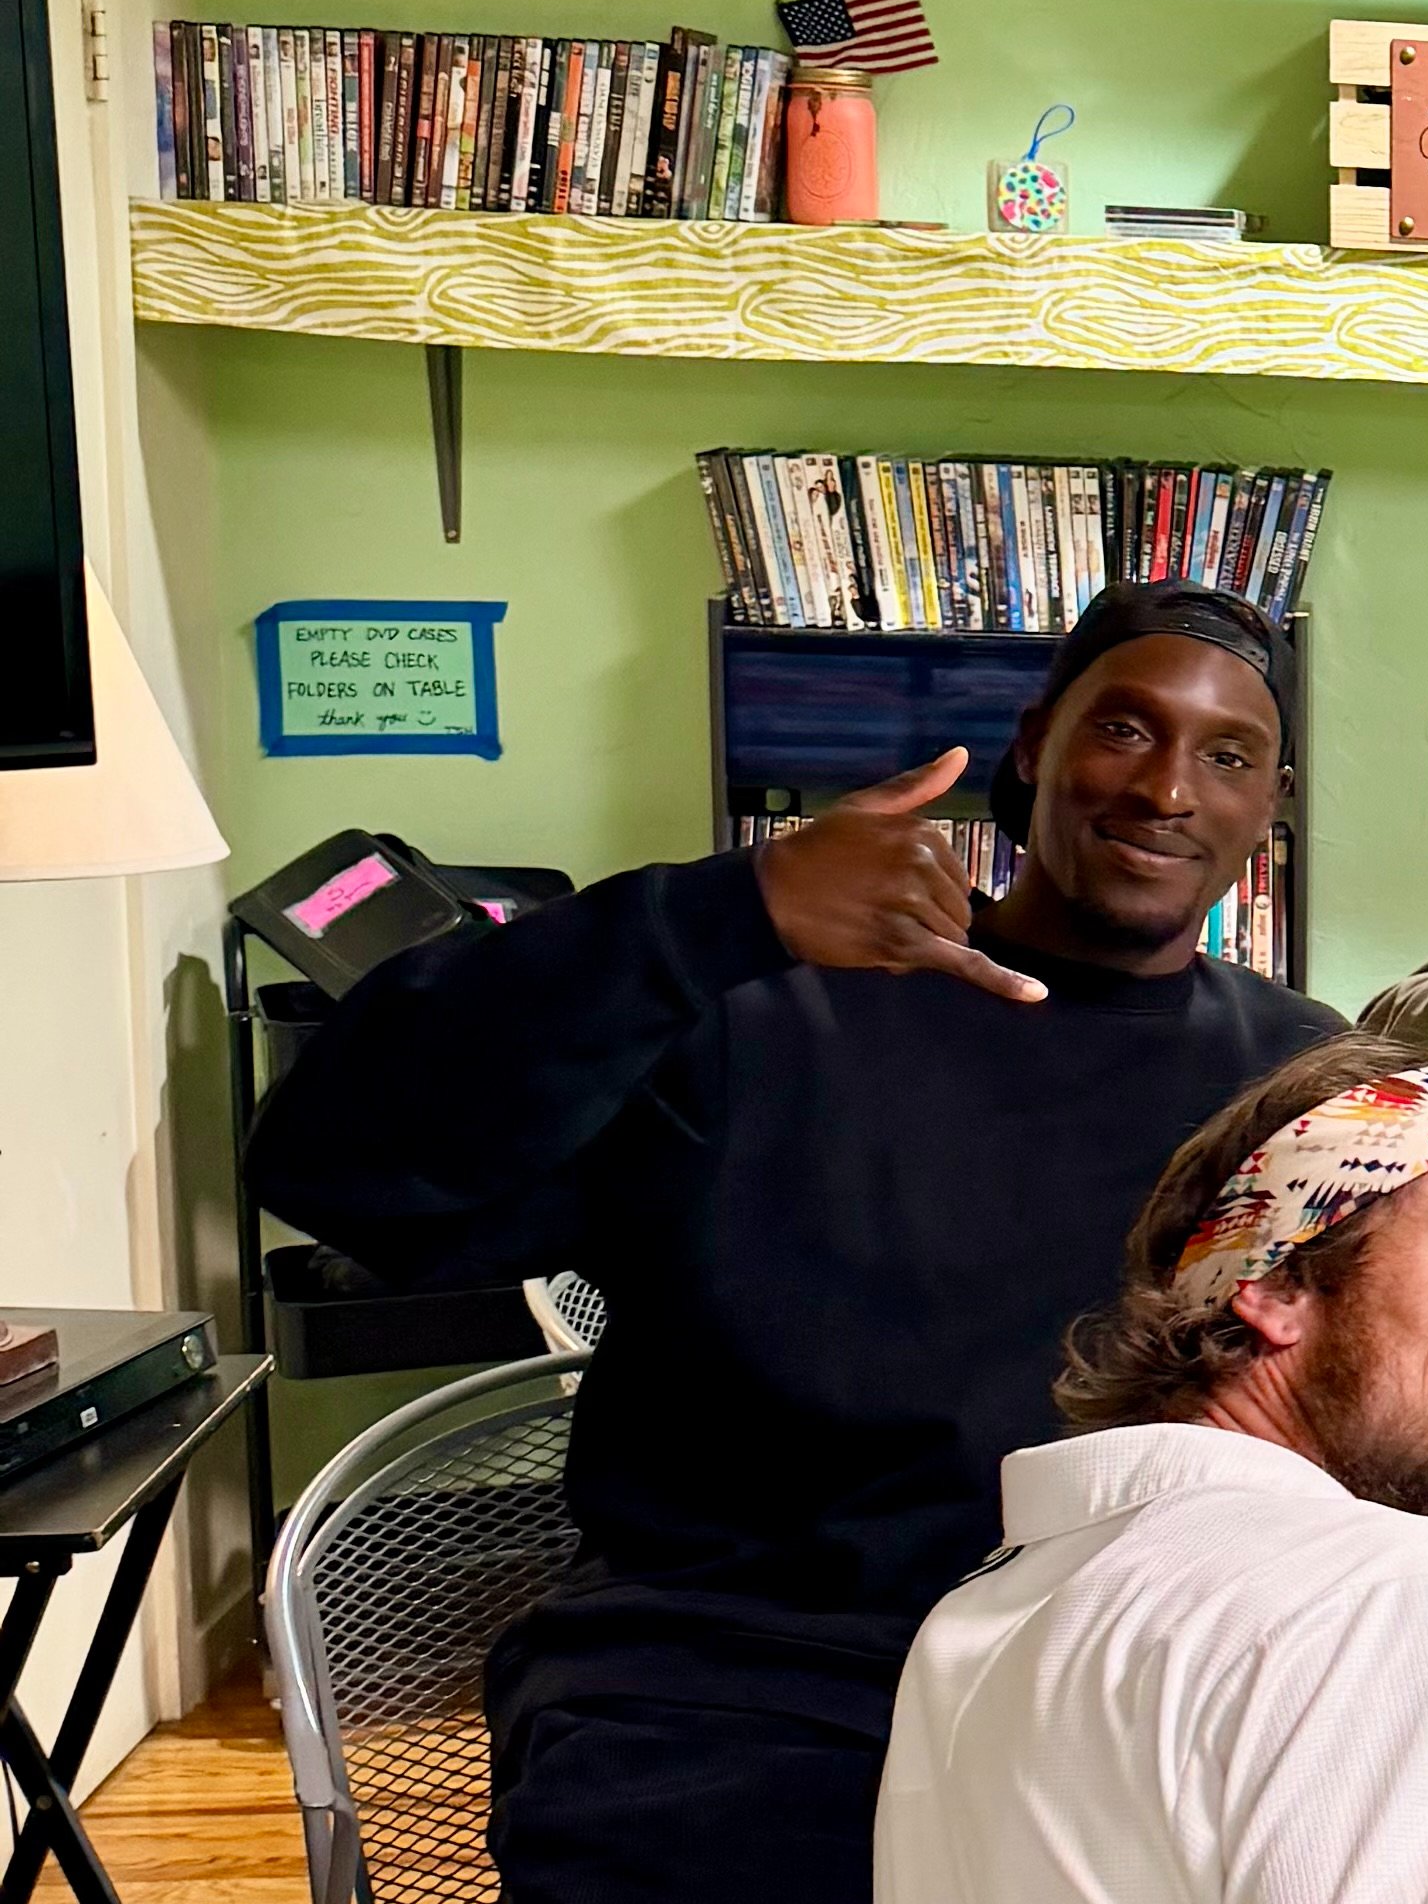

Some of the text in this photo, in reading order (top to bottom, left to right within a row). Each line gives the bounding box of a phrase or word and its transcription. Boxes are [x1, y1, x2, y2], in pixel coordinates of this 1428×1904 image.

[296, 628, 458, 643] EMPTY DVD CASES
[310, 651, 440, 671] PLEASE CHECK
[287, 680, 466, 700] FOLDERS ON TABLE
[318, 708, 408, 731] thank you
